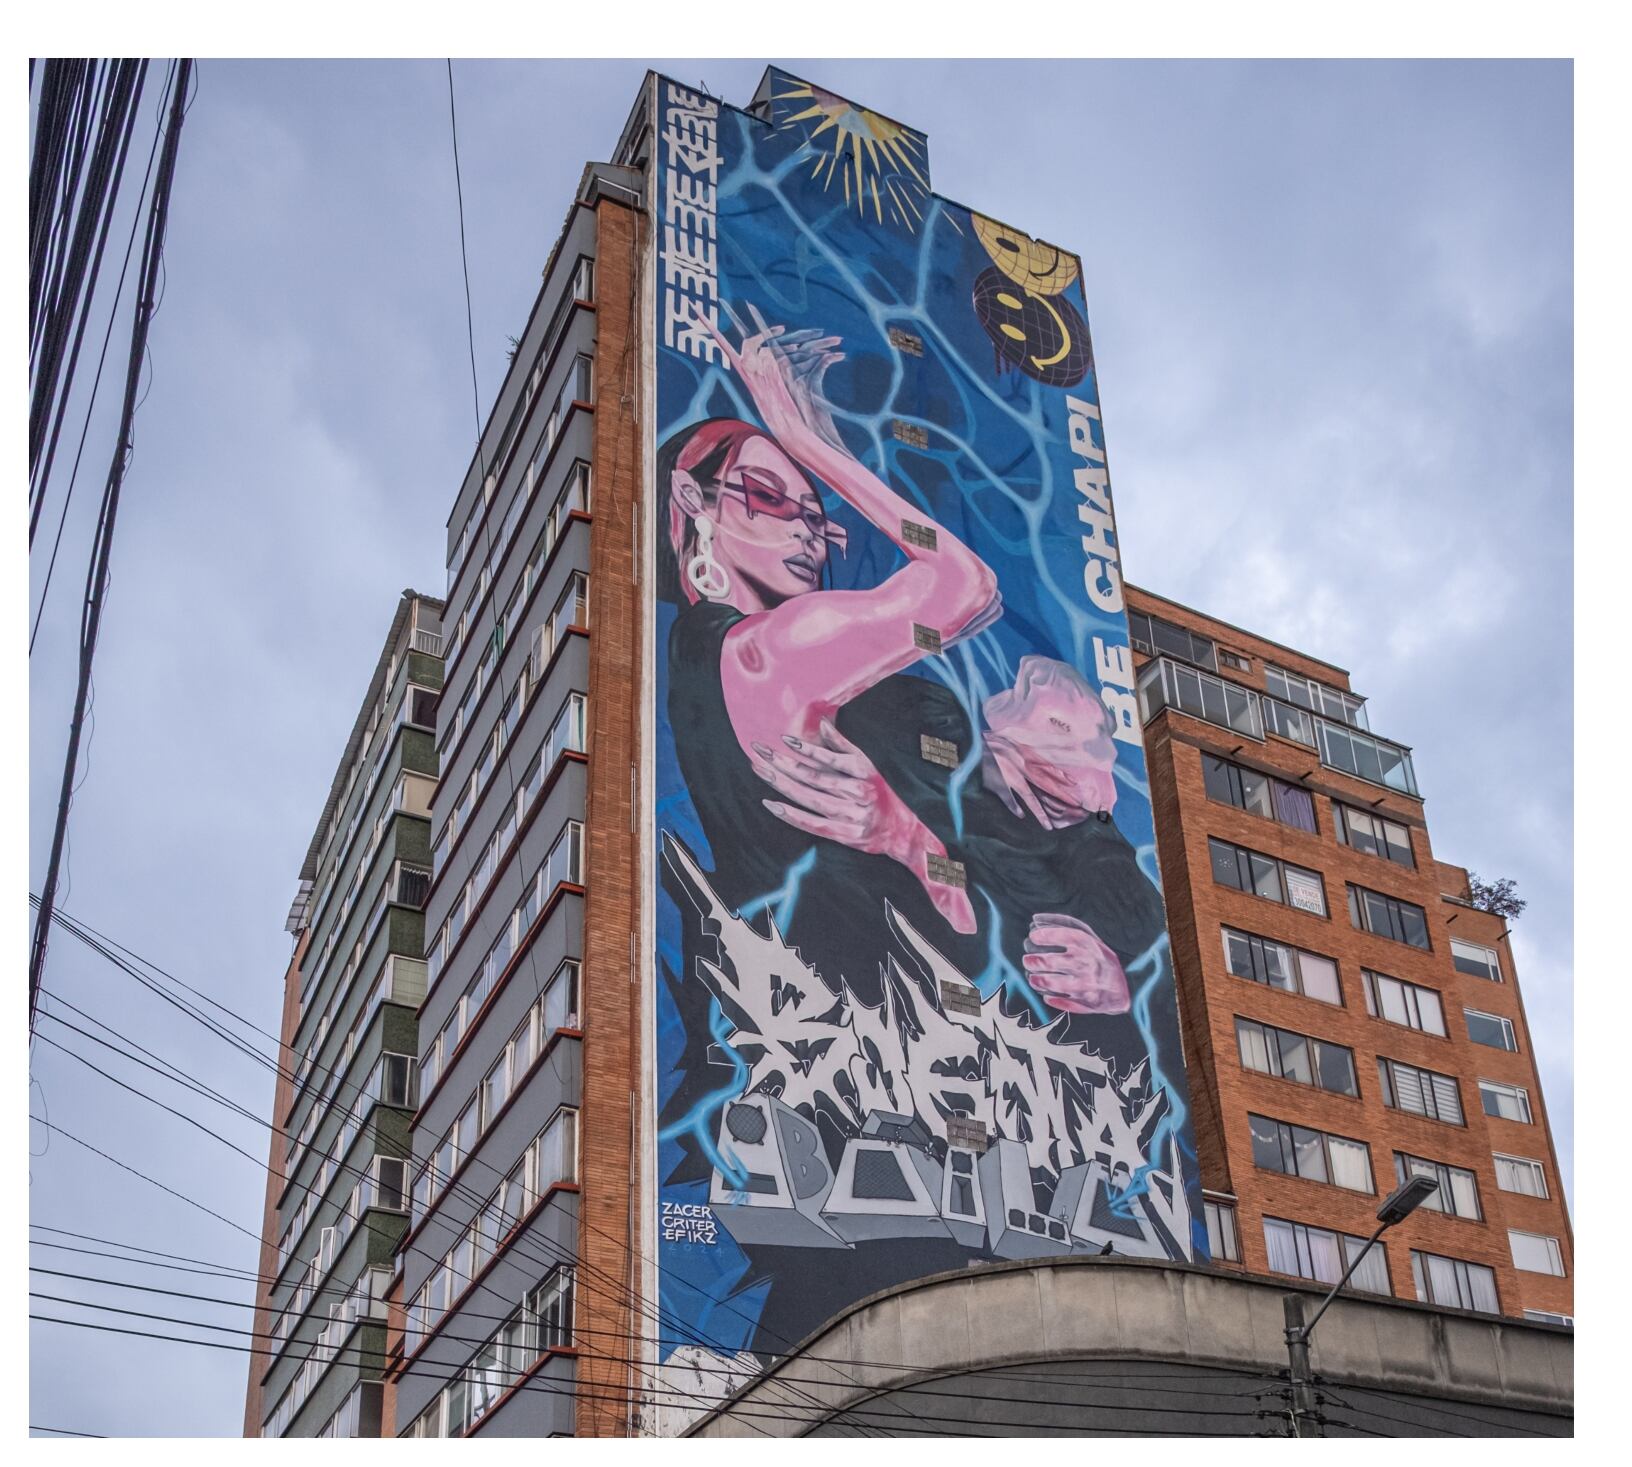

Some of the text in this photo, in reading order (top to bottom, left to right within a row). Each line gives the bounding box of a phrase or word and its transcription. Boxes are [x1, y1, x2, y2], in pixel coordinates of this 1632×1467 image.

[1066, 394, 1125, 614] CHAPI
[662, 1202, 712, 1219] ZACER
[662, 1216, 718, 1234] CRITER
[662, 1229, 717, 1244] EFIKZ
